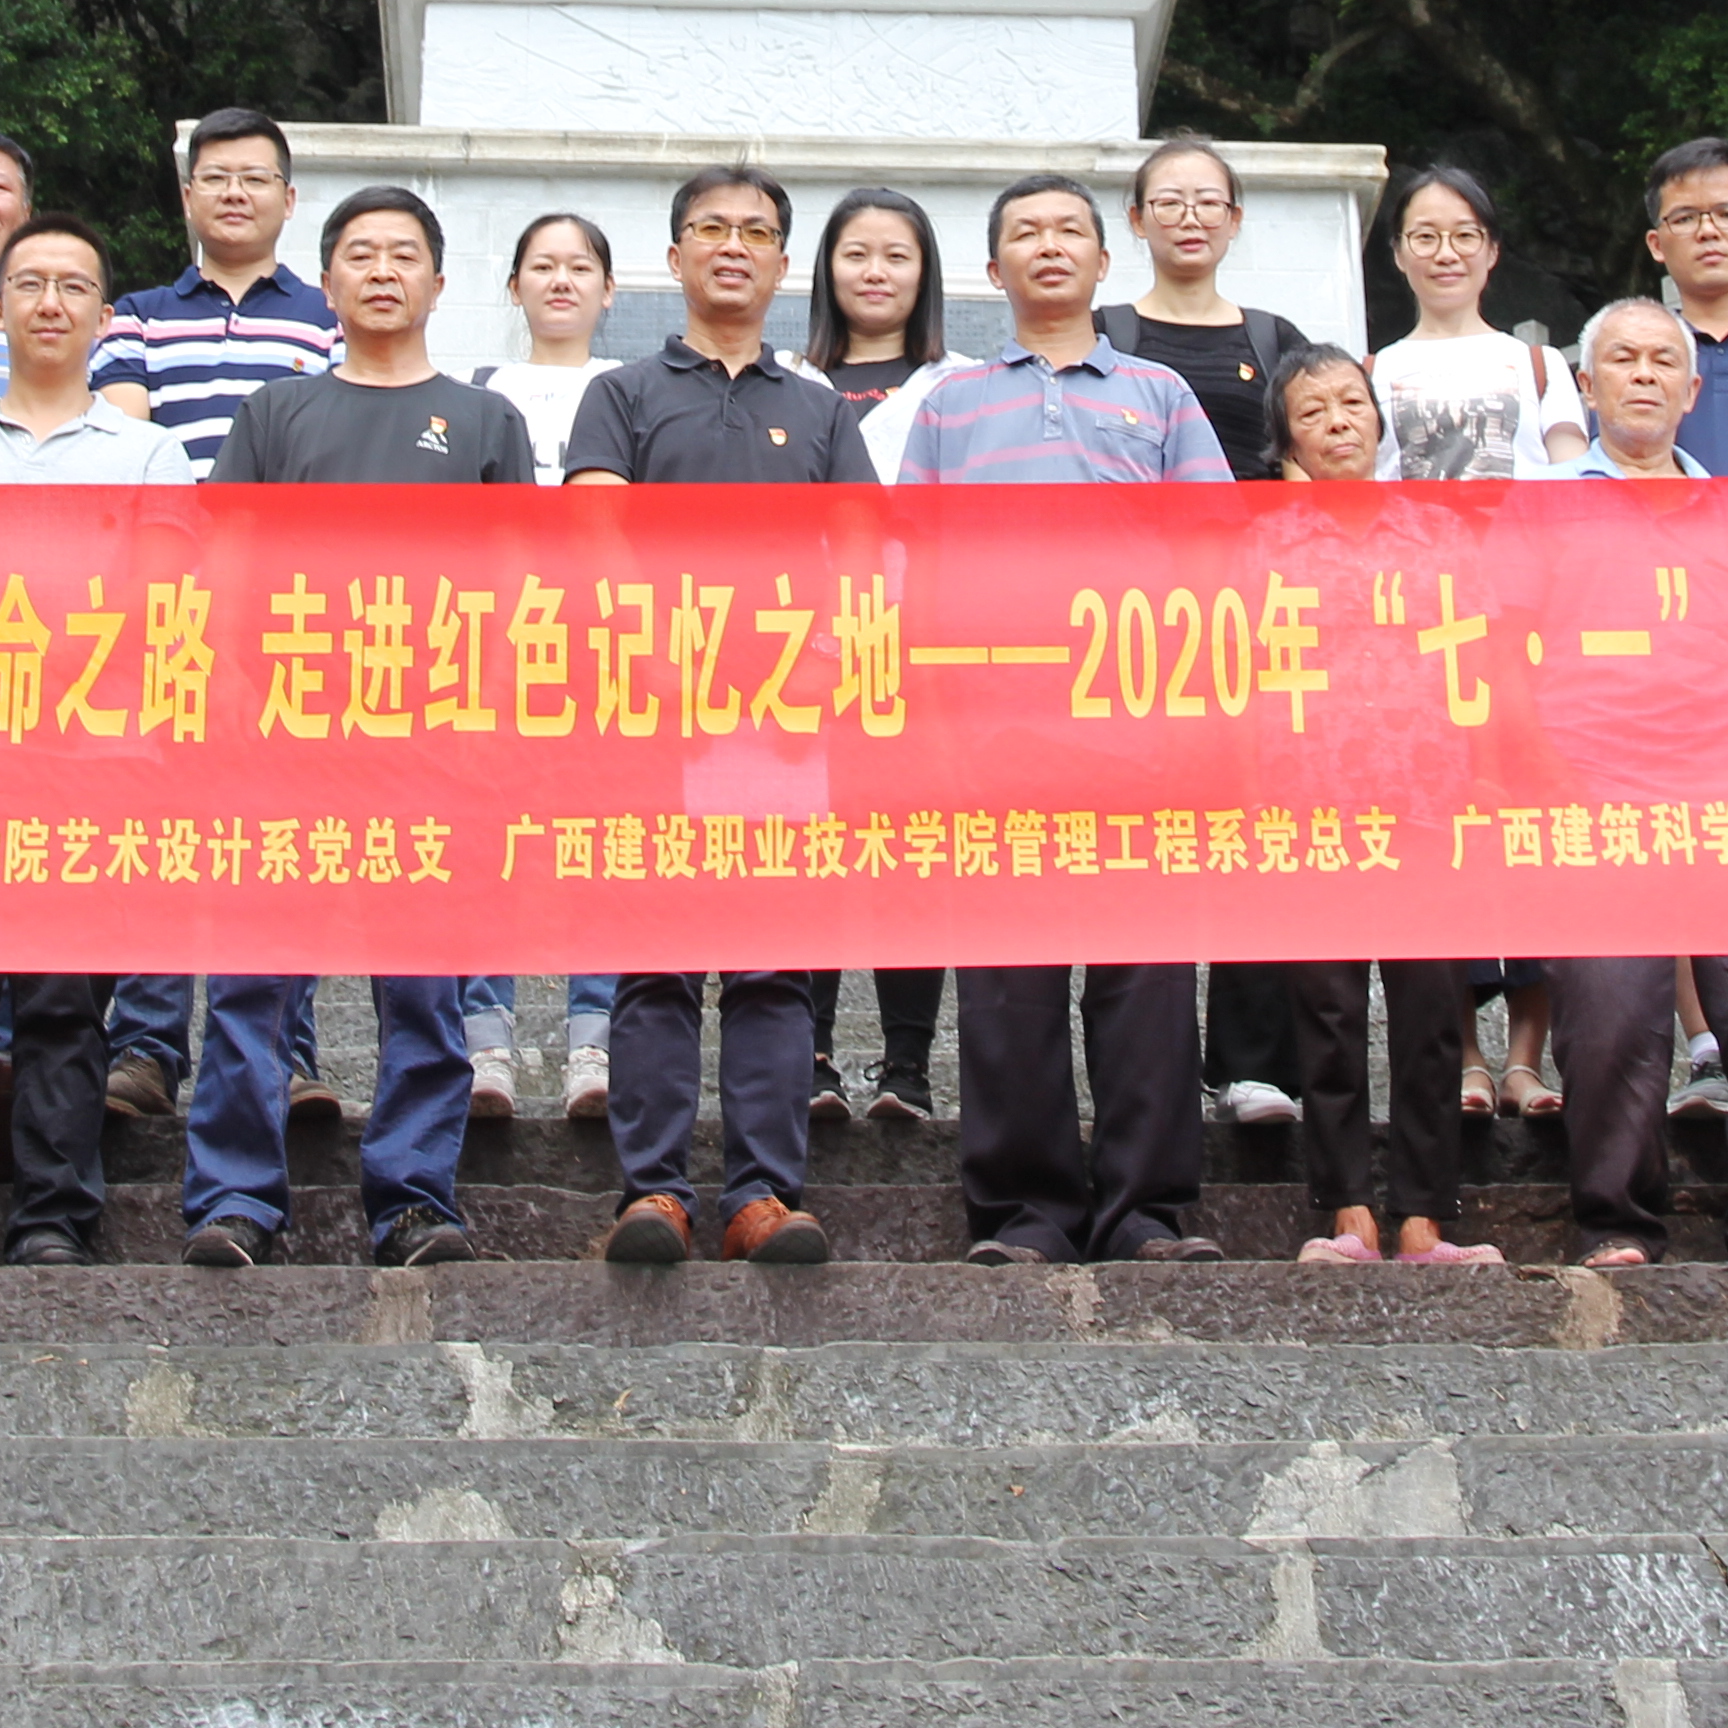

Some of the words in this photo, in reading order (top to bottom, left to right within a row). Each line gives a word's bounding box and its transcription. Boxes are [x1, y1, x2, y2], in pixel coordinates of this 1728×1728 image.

[500, 804, 1402, 880] 广西建设职业技术学院管理工程系党总支
